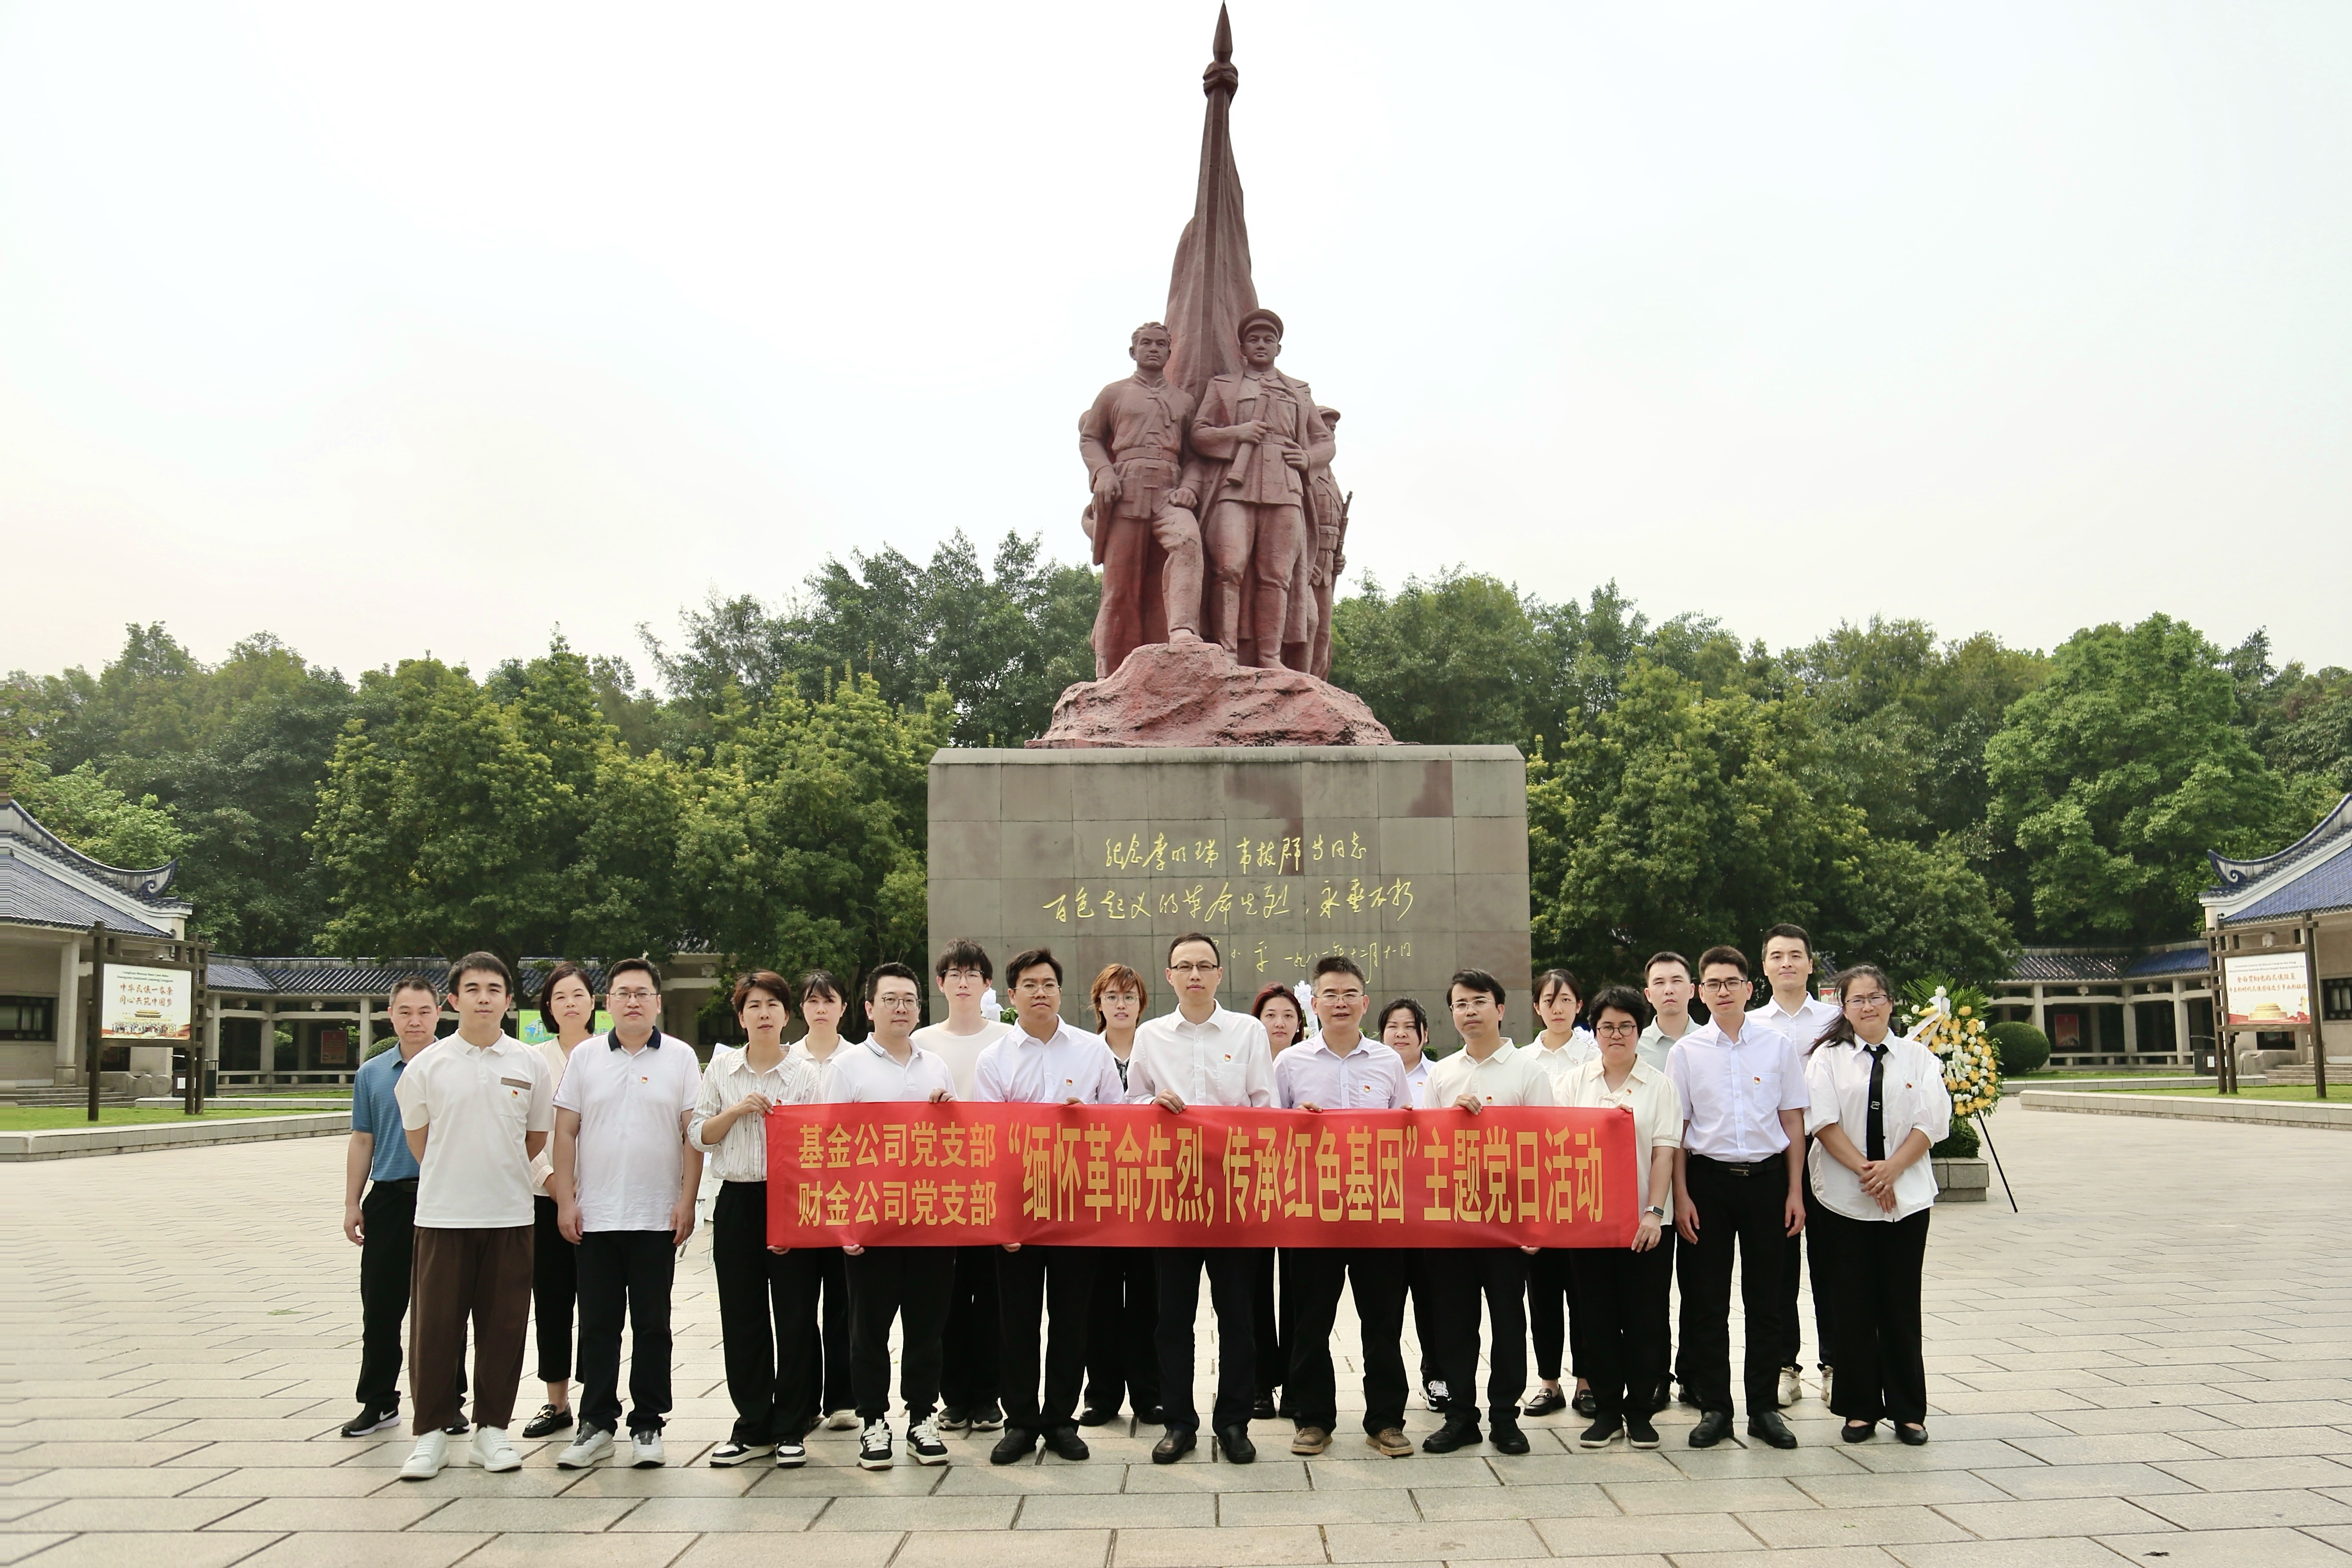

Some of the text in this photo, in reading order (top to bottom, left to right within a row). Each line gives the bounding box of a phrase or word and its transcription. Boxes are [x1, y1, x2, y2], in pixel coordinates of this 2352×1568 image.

[120, 983, 173, 995] 中华民族一家亲
[120, 995, 172, 1007] 同心共筑中国梦
[798, 1121, 997, 1169] 基金公司党支部
[798, 1179, 997, 1227] 财金公司党支部
